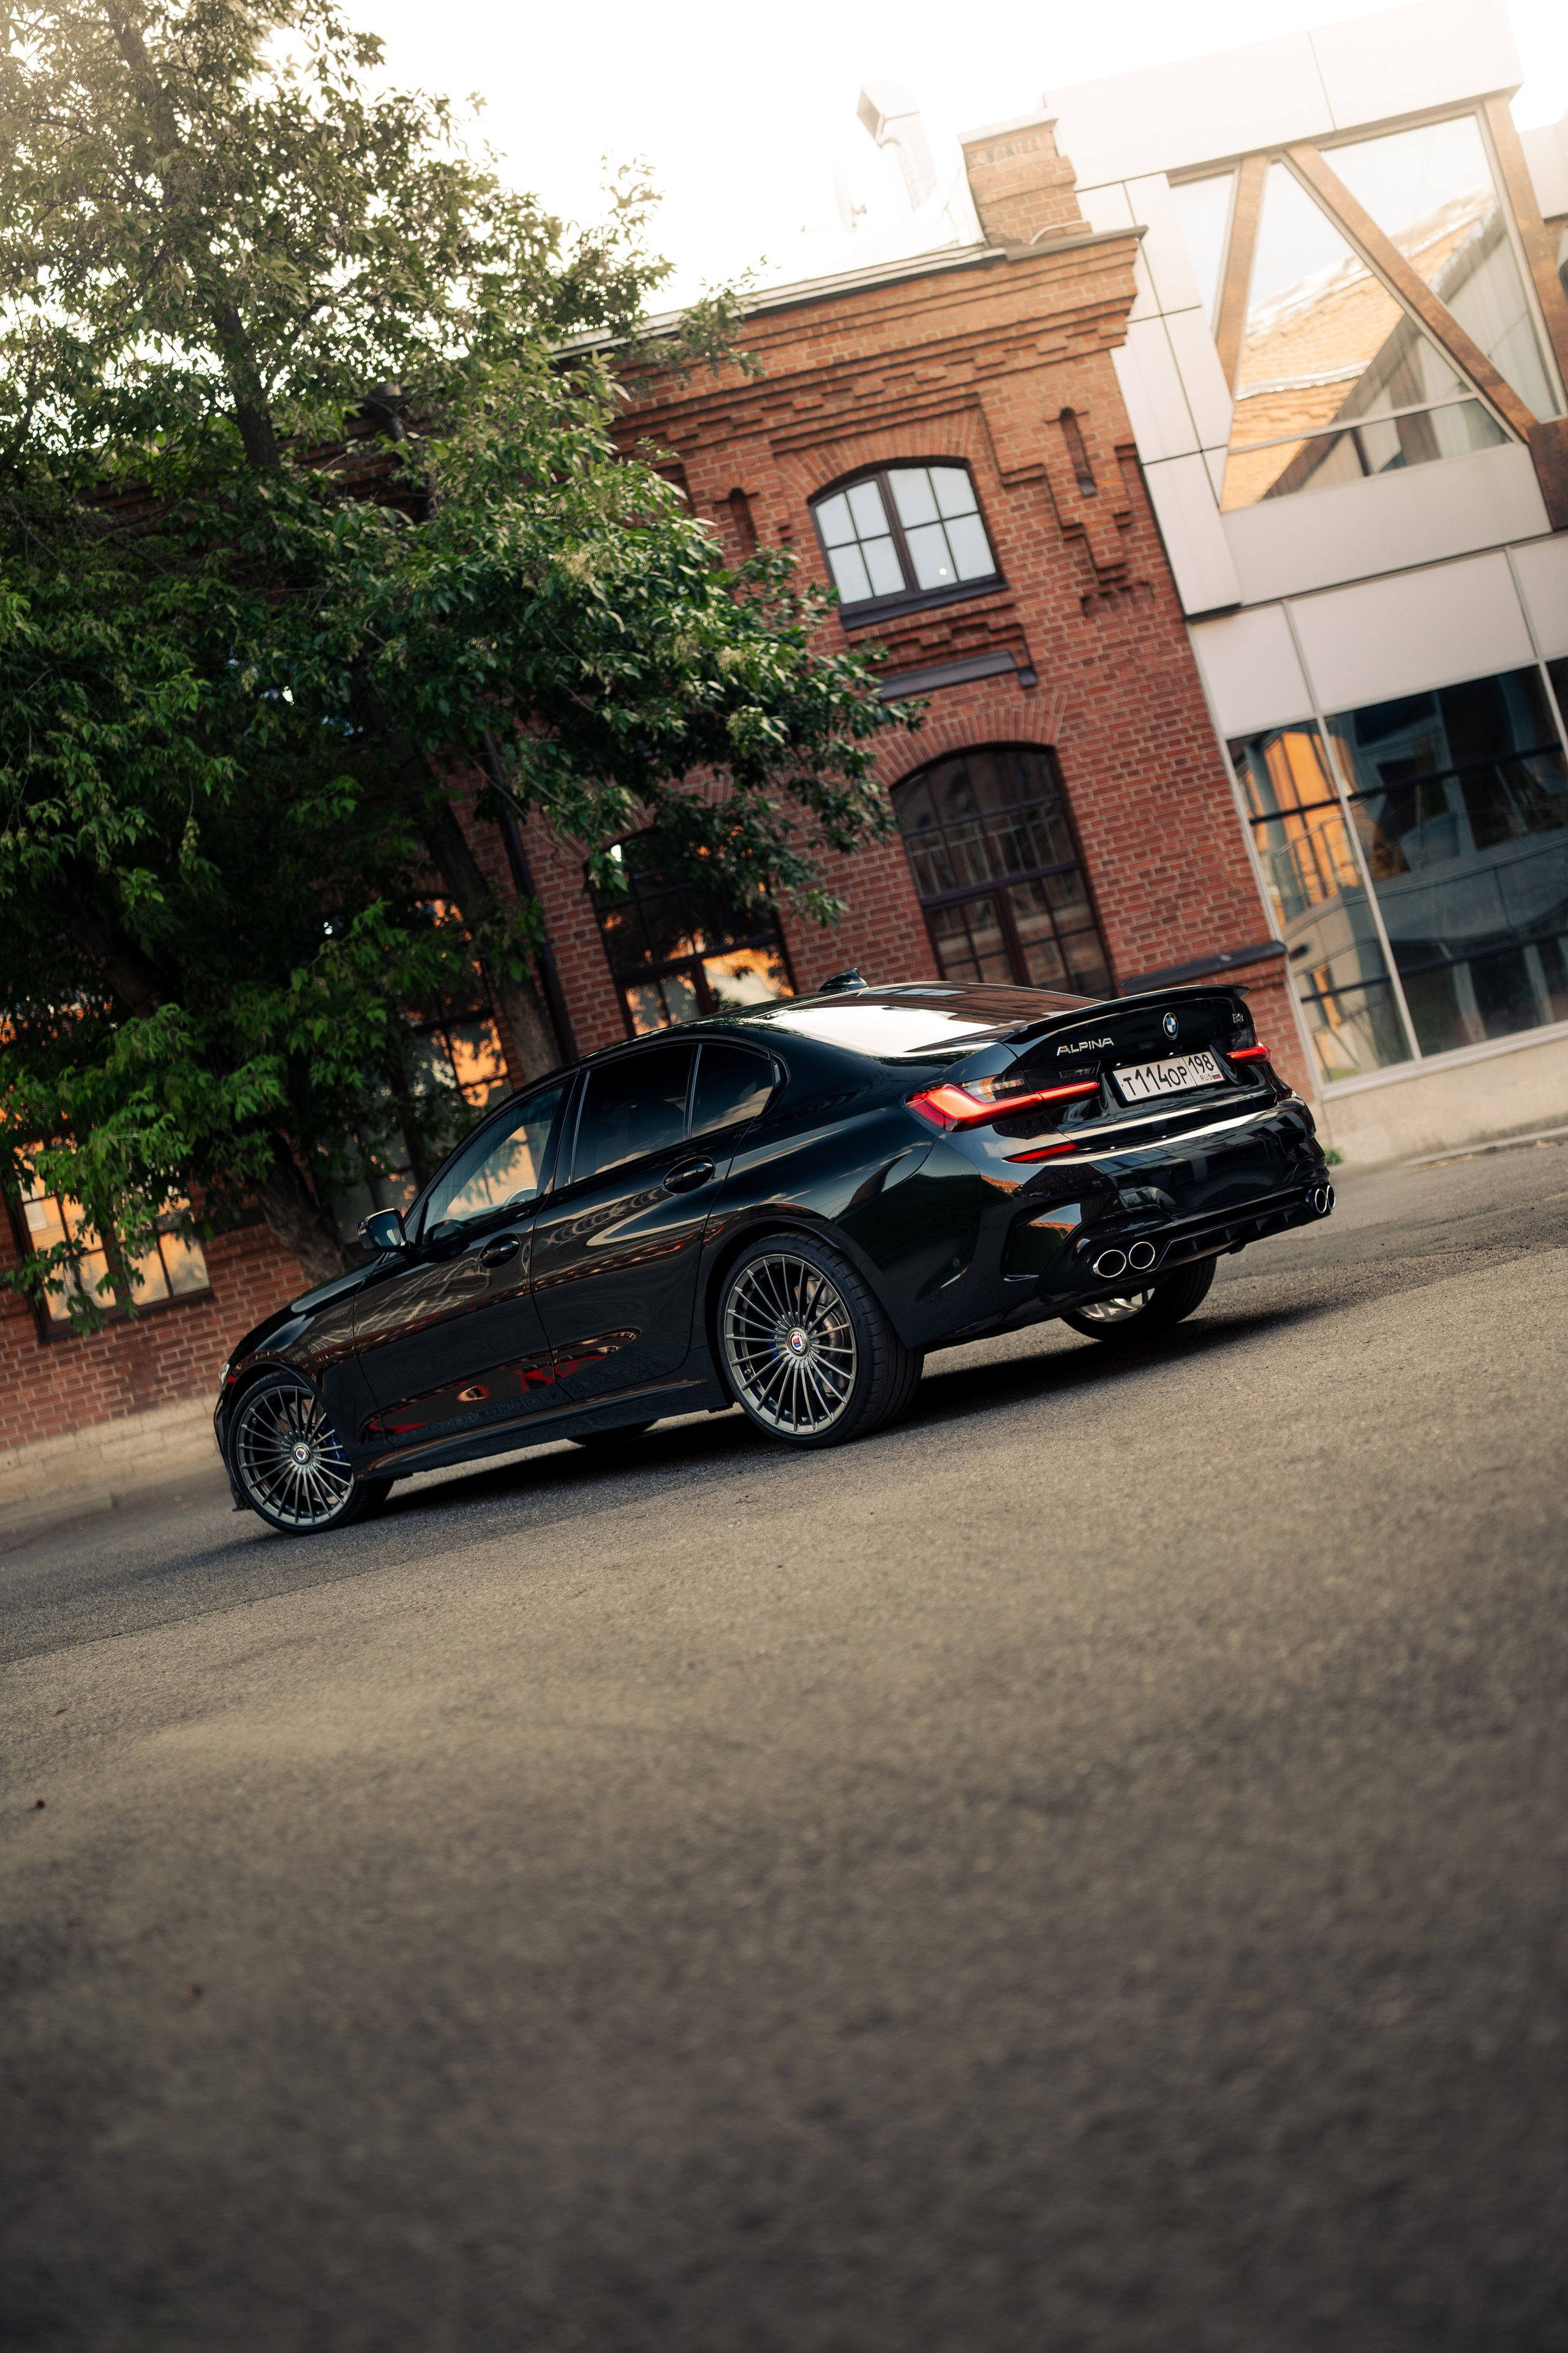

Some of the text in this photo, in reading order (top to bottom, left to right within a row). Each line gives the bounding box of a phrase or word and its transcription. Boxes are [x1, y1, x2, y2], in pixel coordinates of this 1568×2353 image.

[1057, 1037, 1115, 1056] ALPINA
[1123, 1054, 1215, 1096] T114OP 198
[1200, 1073, 1213, 1082] RUS
